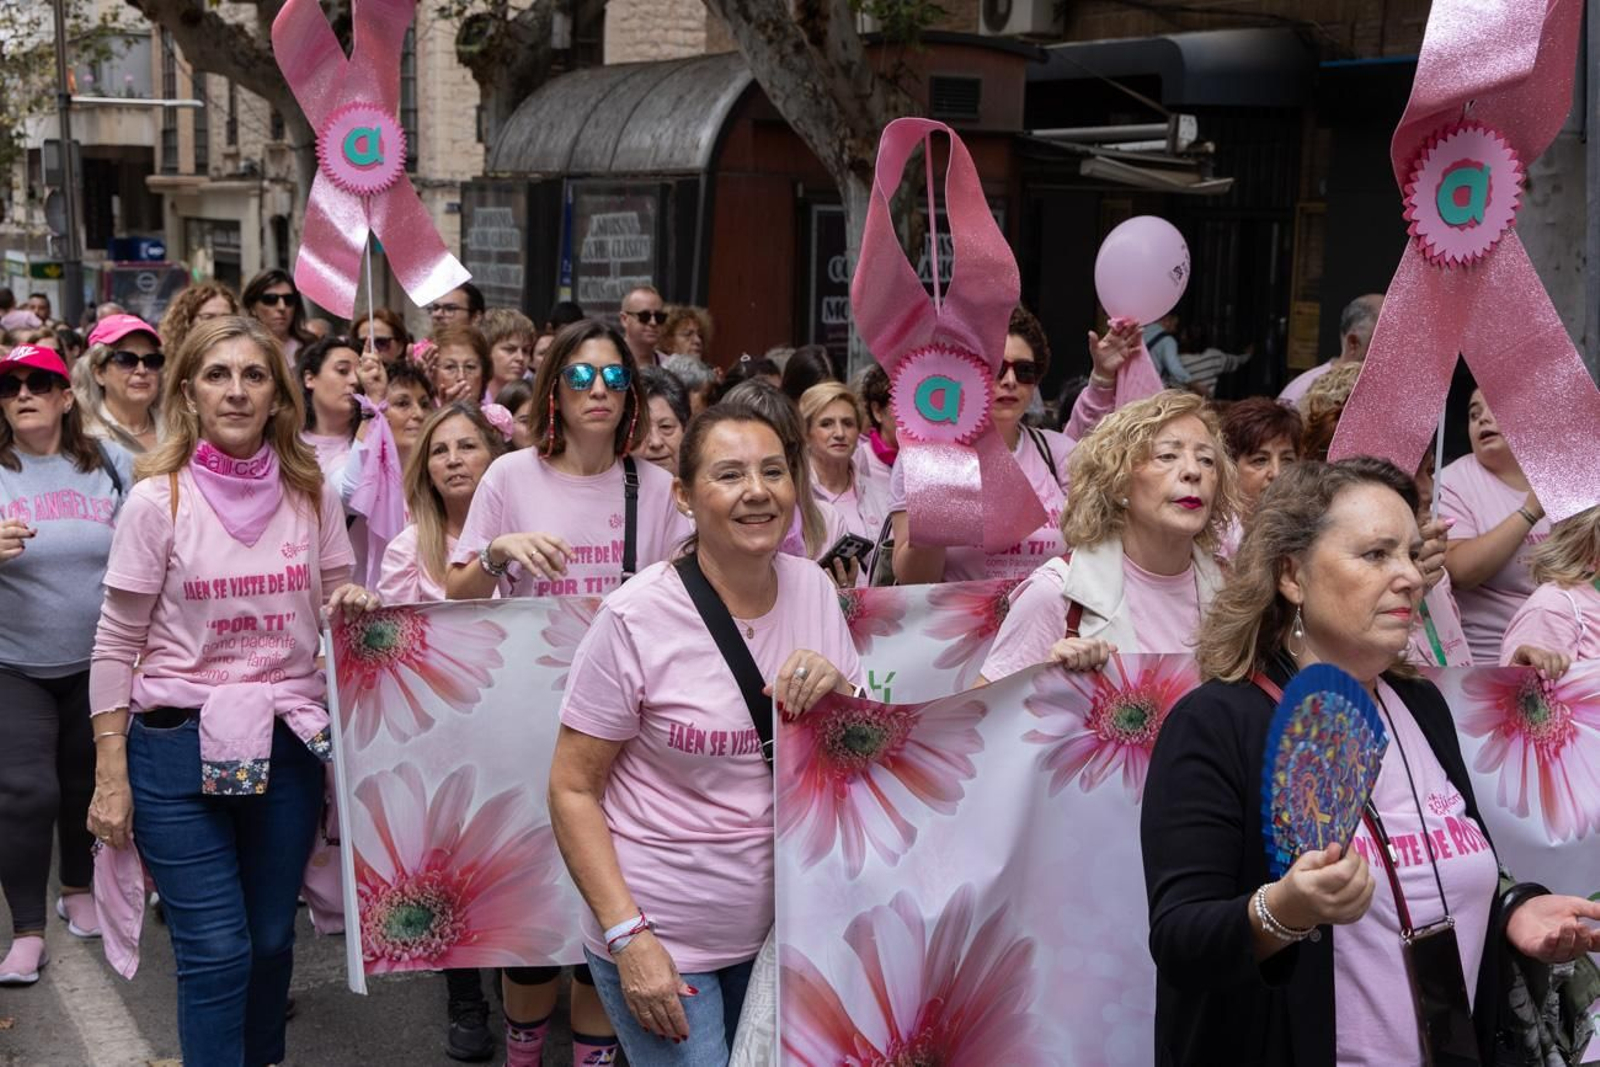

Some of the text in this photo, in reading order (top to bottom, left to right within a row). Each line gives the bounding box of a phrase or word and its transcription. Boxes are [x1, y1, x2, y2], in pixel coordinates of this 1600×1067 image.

[594, 546, 610, 564] DE
[213, 578, 227, 600] SE
[229, 575, 266, 598] VISTE
[268, 574, 285, 595] DE
[667, 722, 707, 755] JAÉN
[709, 730, 728, 757] SE
[1420, 829, 1452, 862] DE
